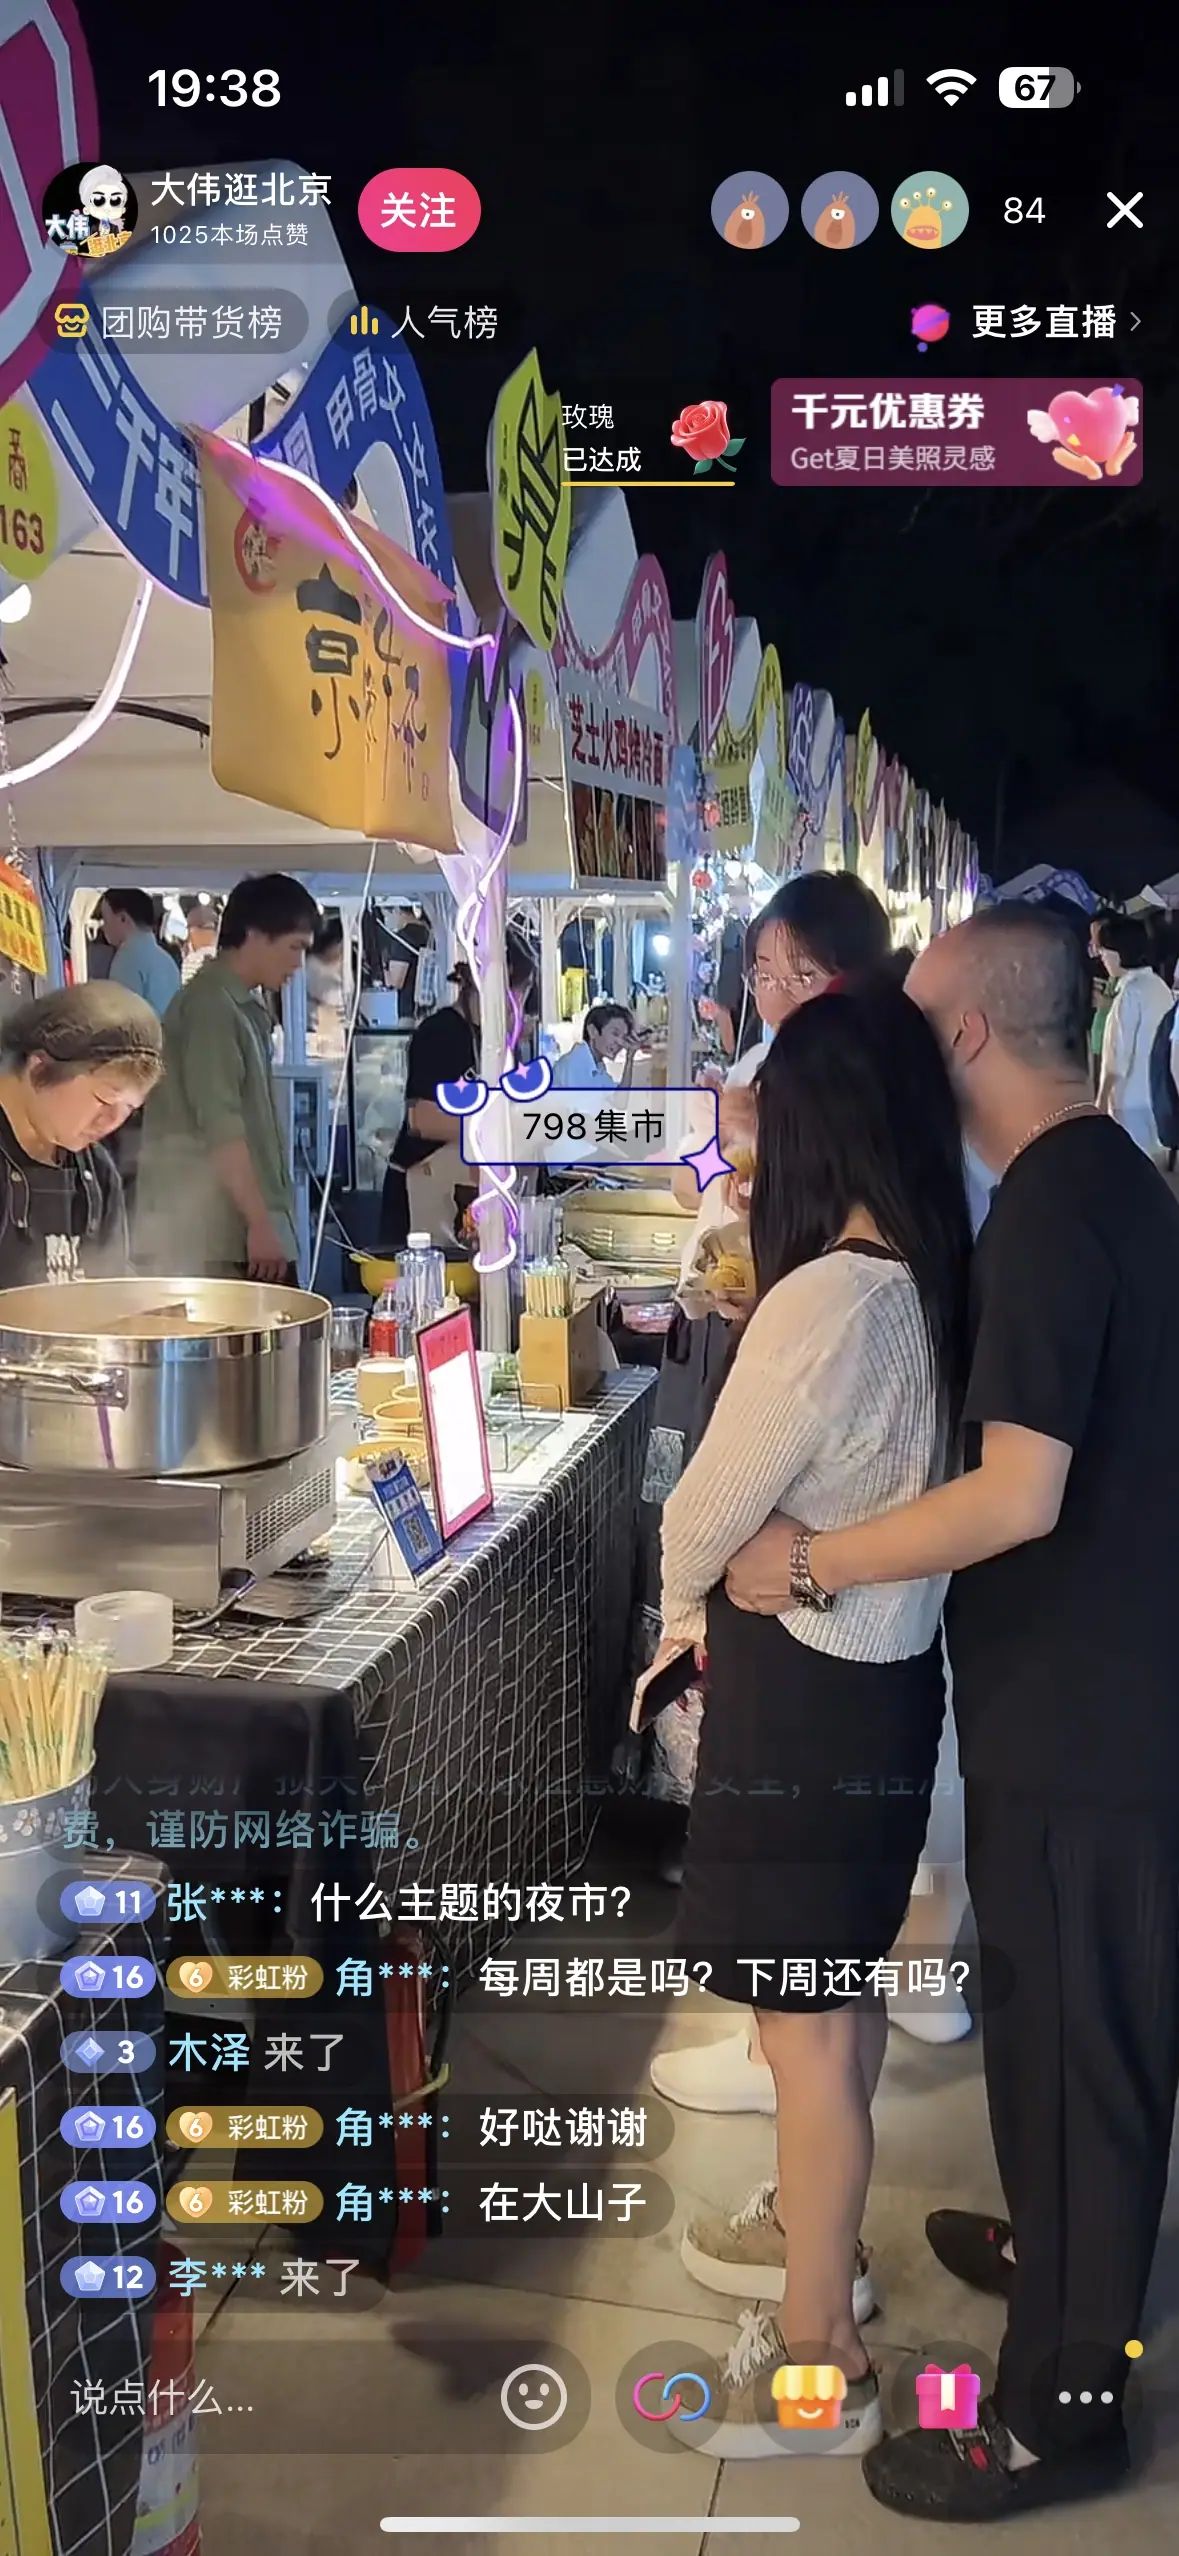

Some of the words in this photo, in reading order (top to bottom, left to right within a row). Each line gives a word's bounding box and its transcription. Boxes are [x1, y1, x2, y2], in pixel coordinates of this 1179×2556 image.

[0, 504, 45, 554] 163
[568, 692, 664, 788] 芝士火鸡烤冷面
